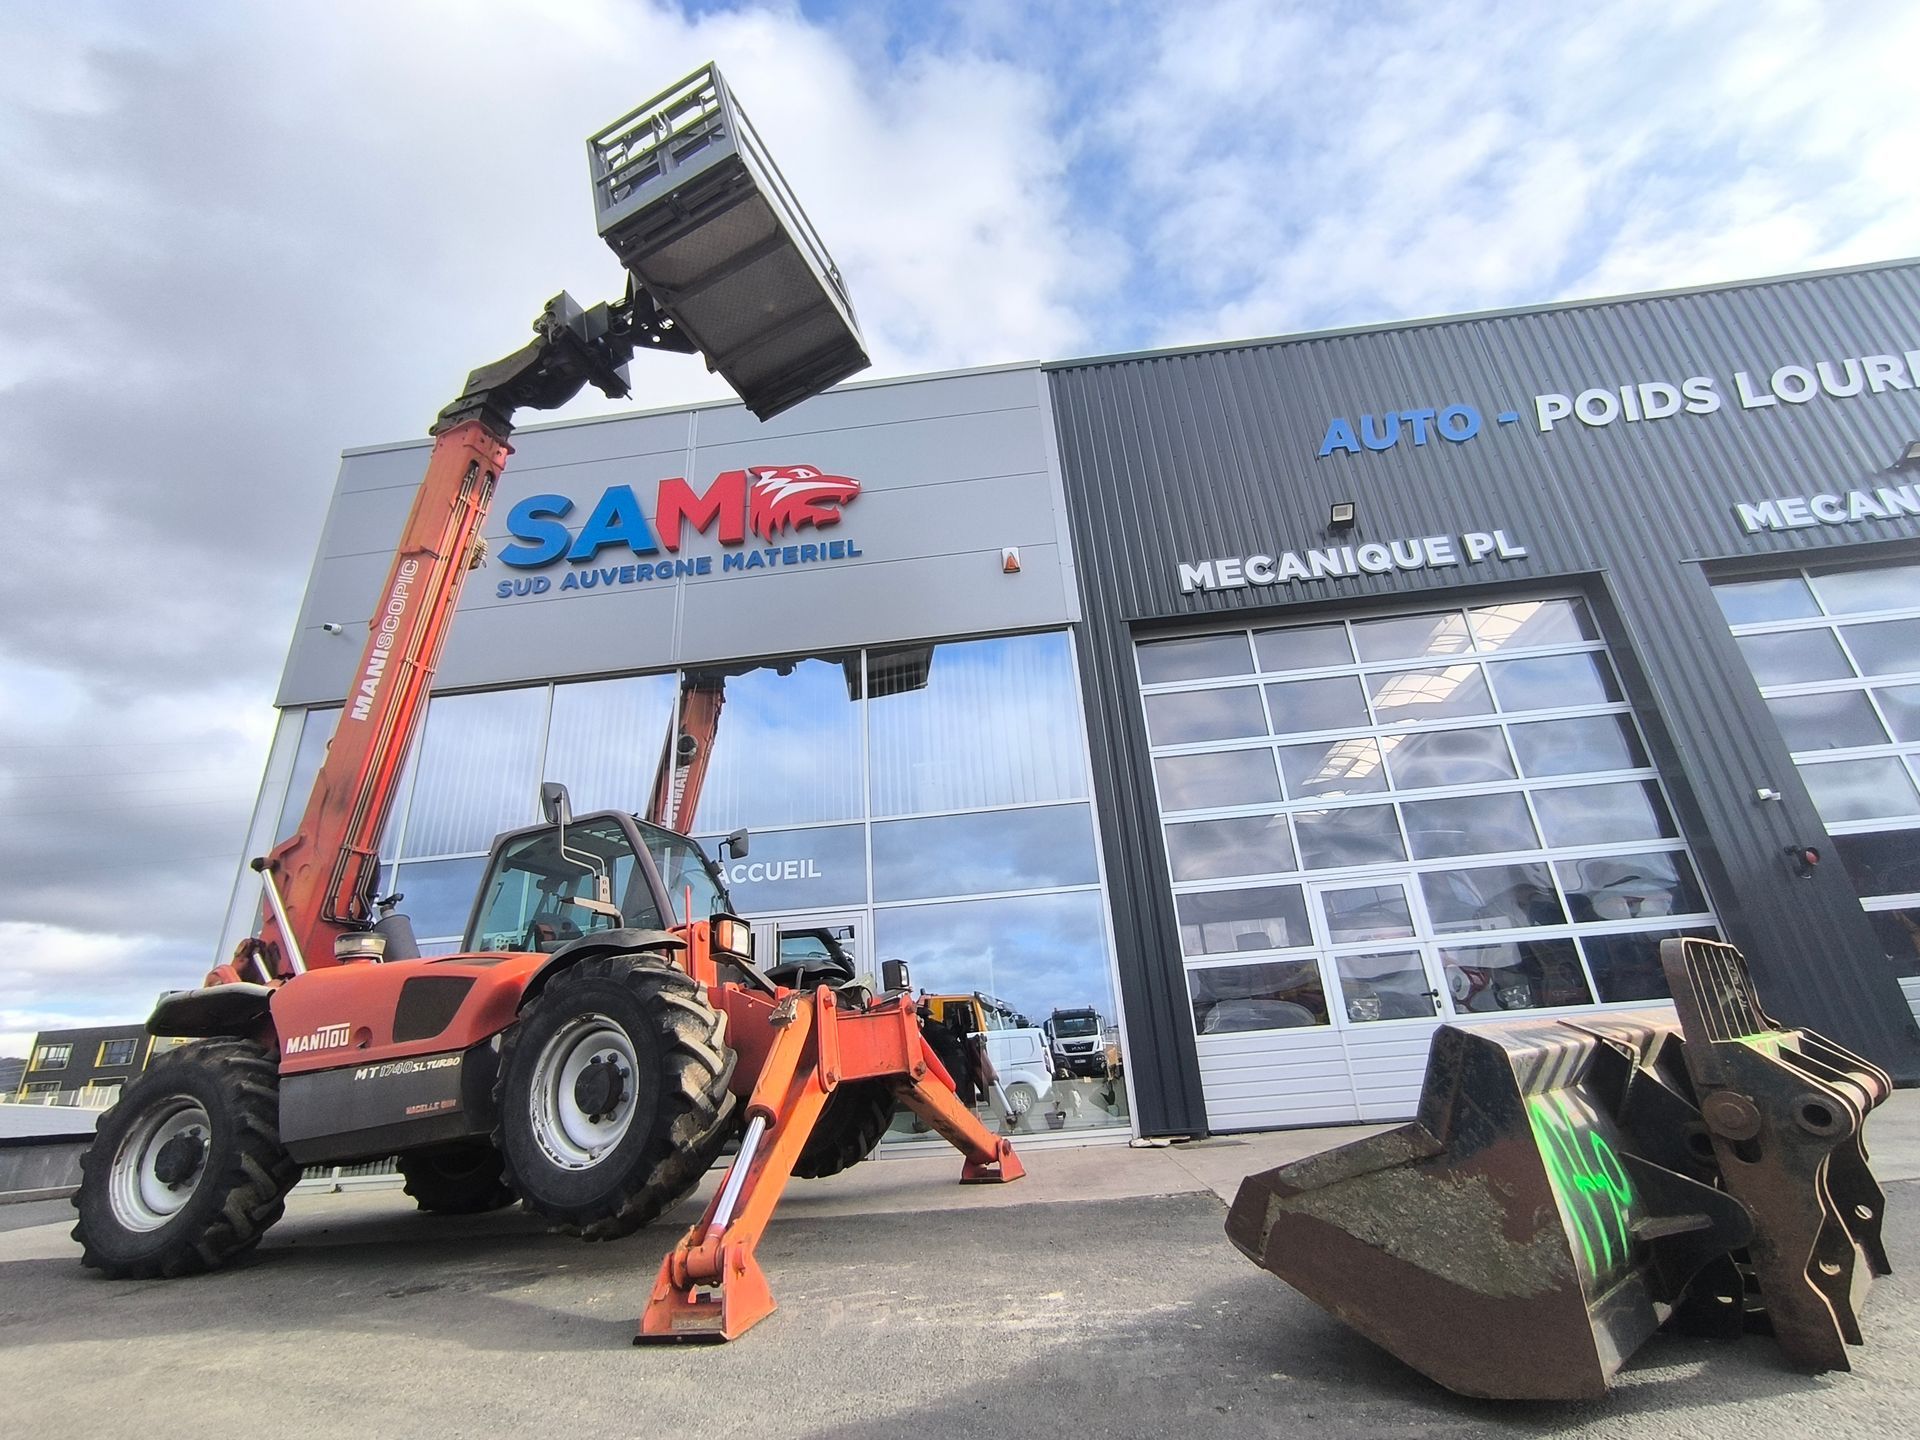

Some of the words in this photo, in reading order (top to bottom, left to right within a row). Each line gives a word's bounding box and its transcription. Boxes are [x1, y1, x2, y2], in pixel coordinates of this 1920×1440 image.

[1318, 405, 1482, 457] AUTO
[1498, 410, 1519, 424] -
[1535, 376, 1721, 432] POIDS
[497, 469, 748, 570] SAM
[497, 576, 552, 598] SUD
[560, 556, 713, 592] AUVERGNE
[722, 538, 863, 571] MATERIEL
[1178, 534, 1456, 594] MECANIQUE
[1463, 529, 1527, 563] PL
[351, 559, 419, 722] MANISCOPIC
[717, 859, 822, 885] ACCUEIL
[286, 1022, 350, 1054] MANITOU
[355, 1066, 380, 1081] MT
